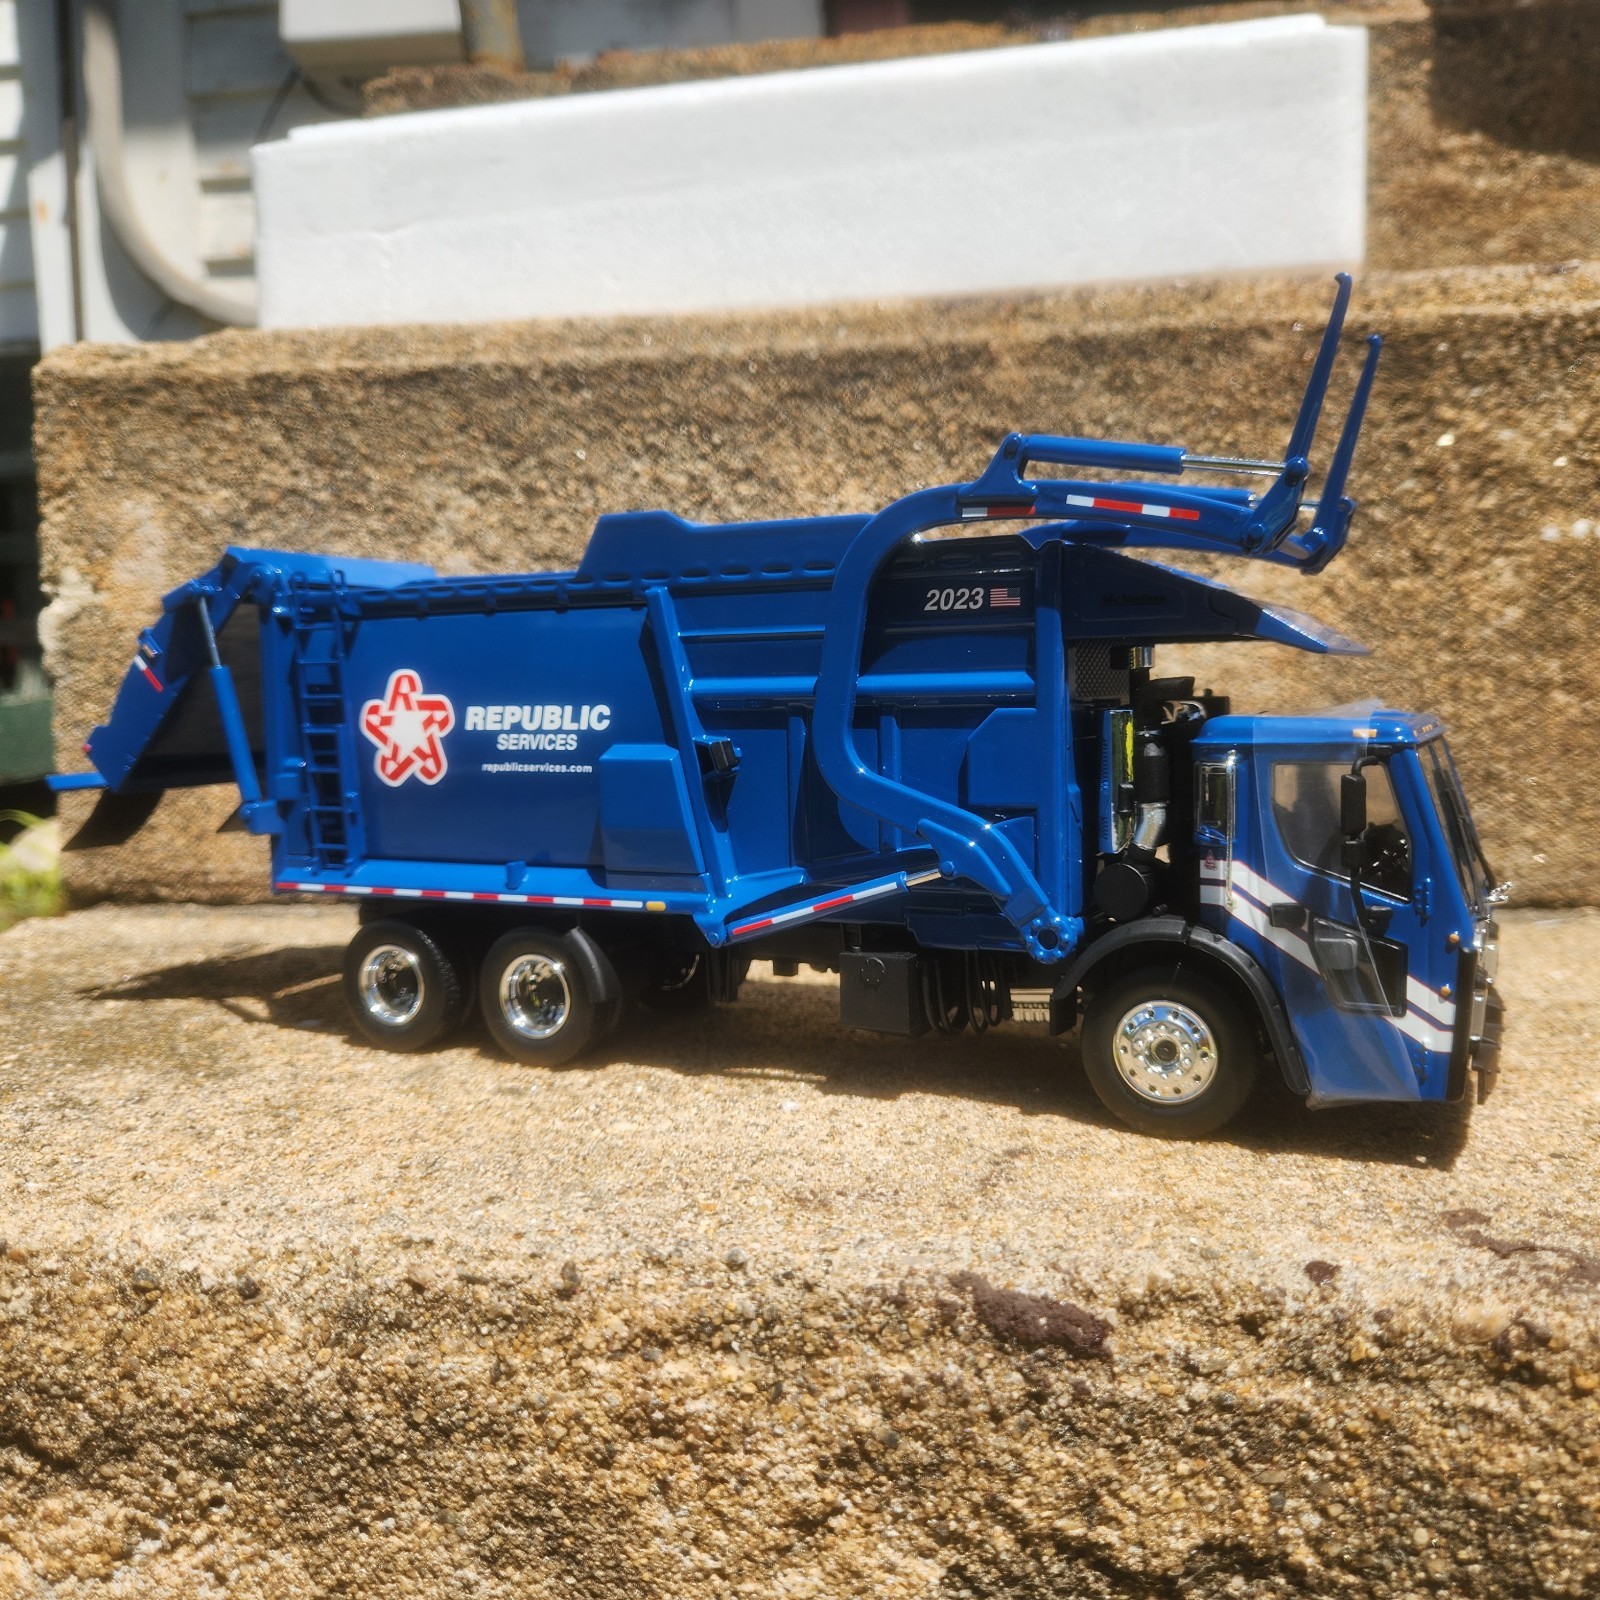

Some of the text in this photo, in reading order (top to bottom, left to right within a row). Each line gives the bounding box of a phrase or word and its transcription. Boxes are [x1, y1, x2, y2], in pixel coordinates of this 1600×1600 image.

[924, 587, 984, 611] 2023
[465, 704, 611, 731] REPUBLIC
[497, 733, 578, 751] SERVICES
[482, 761, 593, 774] republicservices.com
